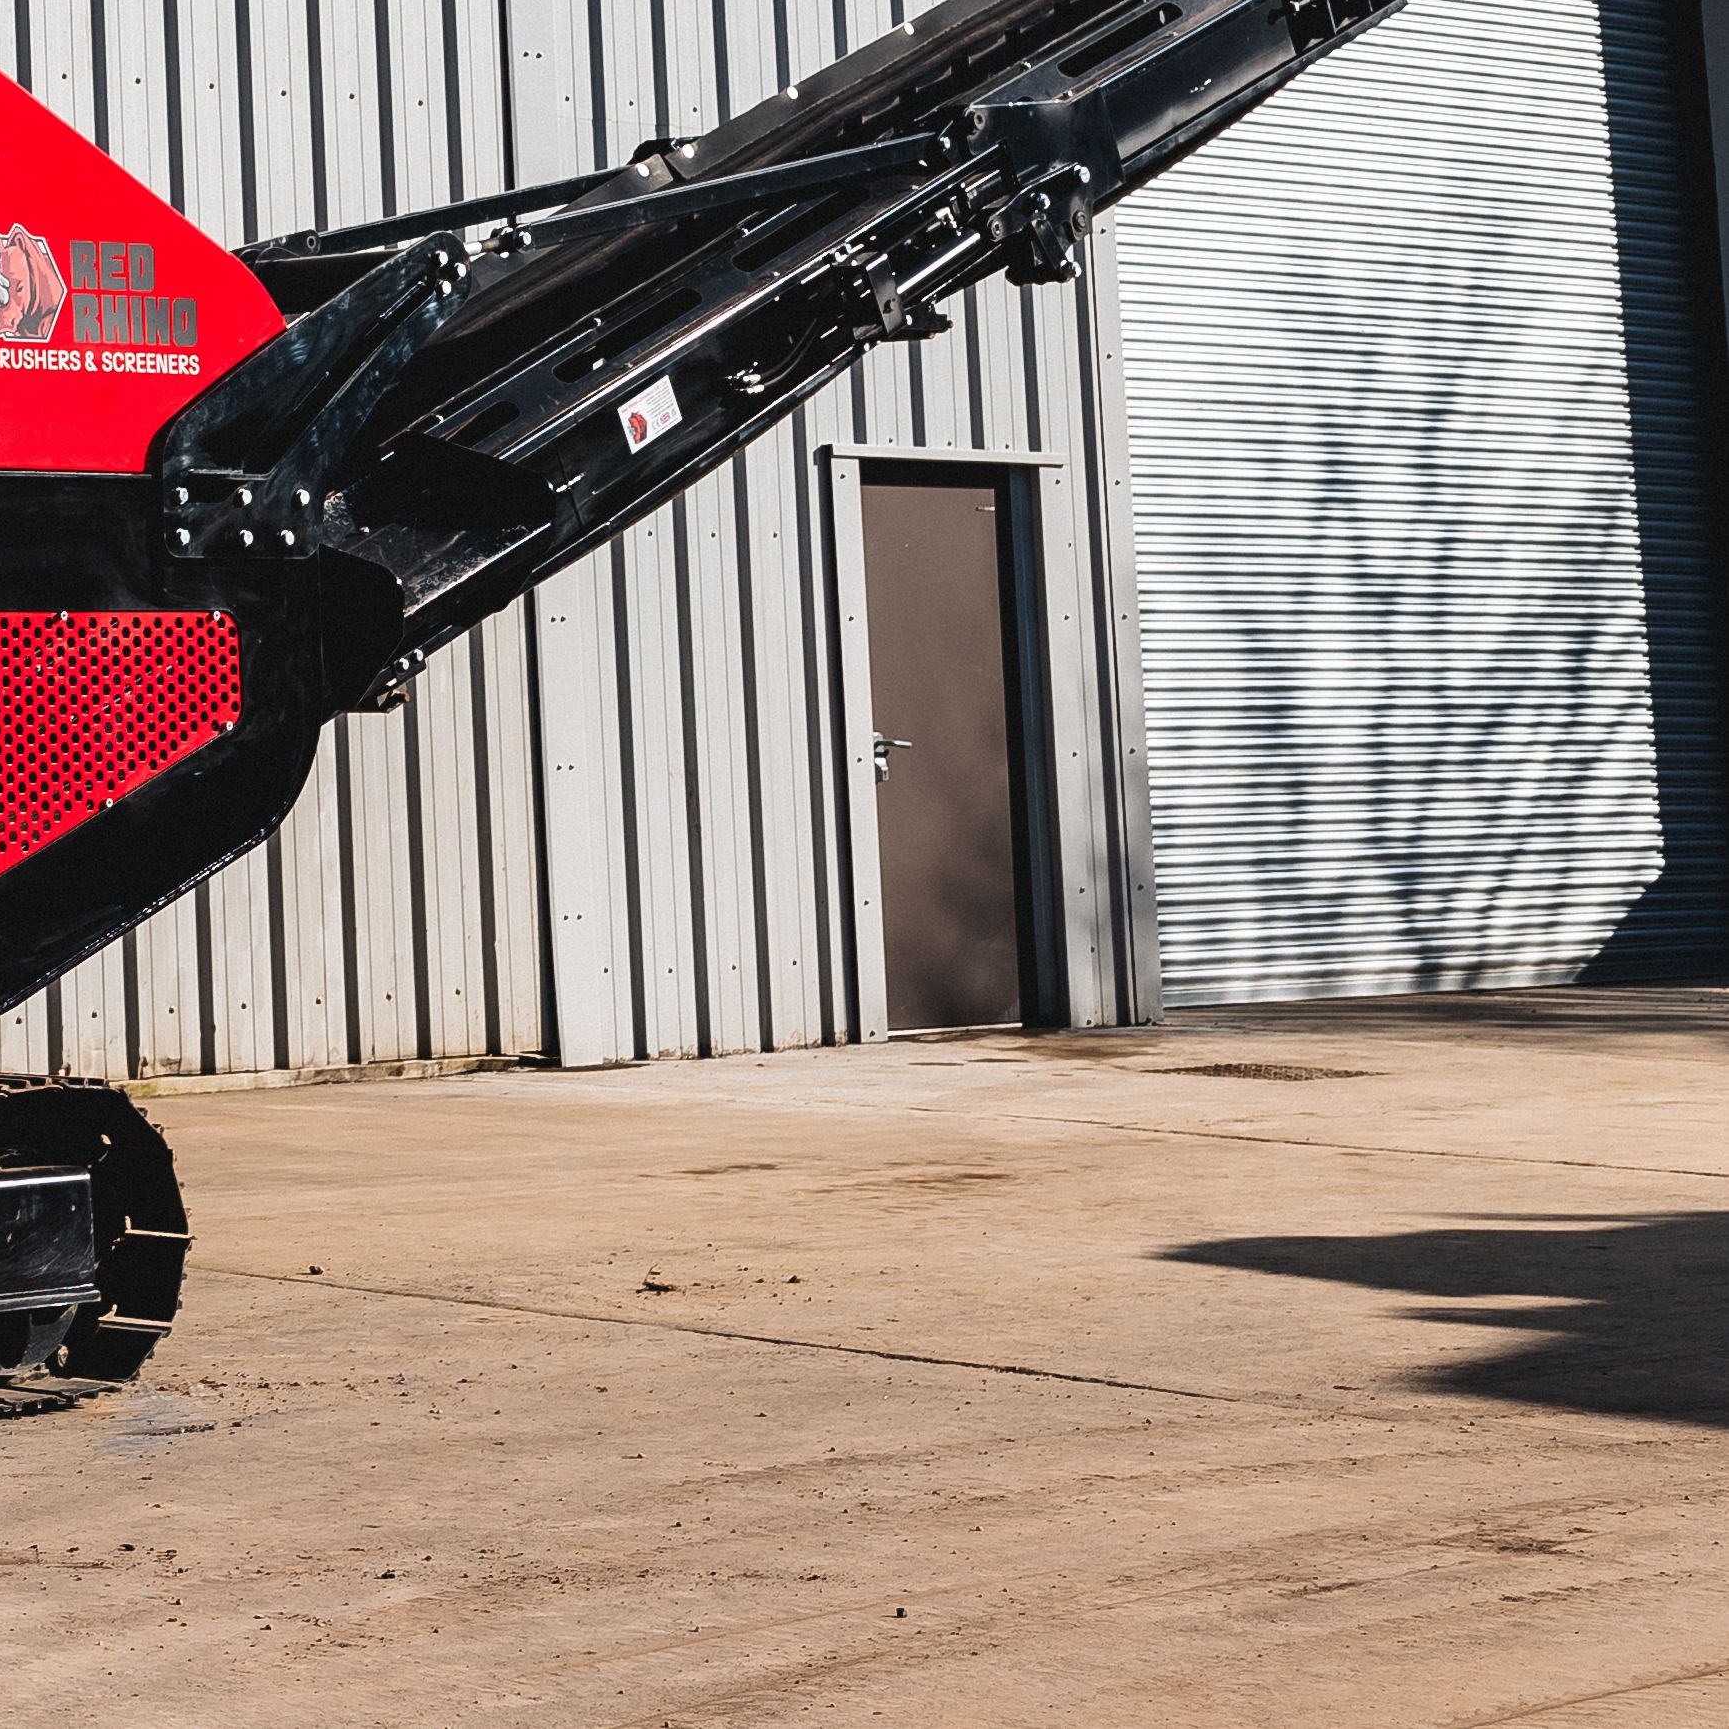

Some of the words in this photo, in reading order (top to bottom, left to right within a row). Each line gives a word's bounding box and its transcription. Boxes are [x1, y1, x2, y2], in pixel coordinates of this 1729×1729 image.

[70, 240, 156, 292] RED
[72, 294, 199, 347] RHINO
[84, 352, 99, 373] &
[101, 353, 201, 376] SCREENERS
